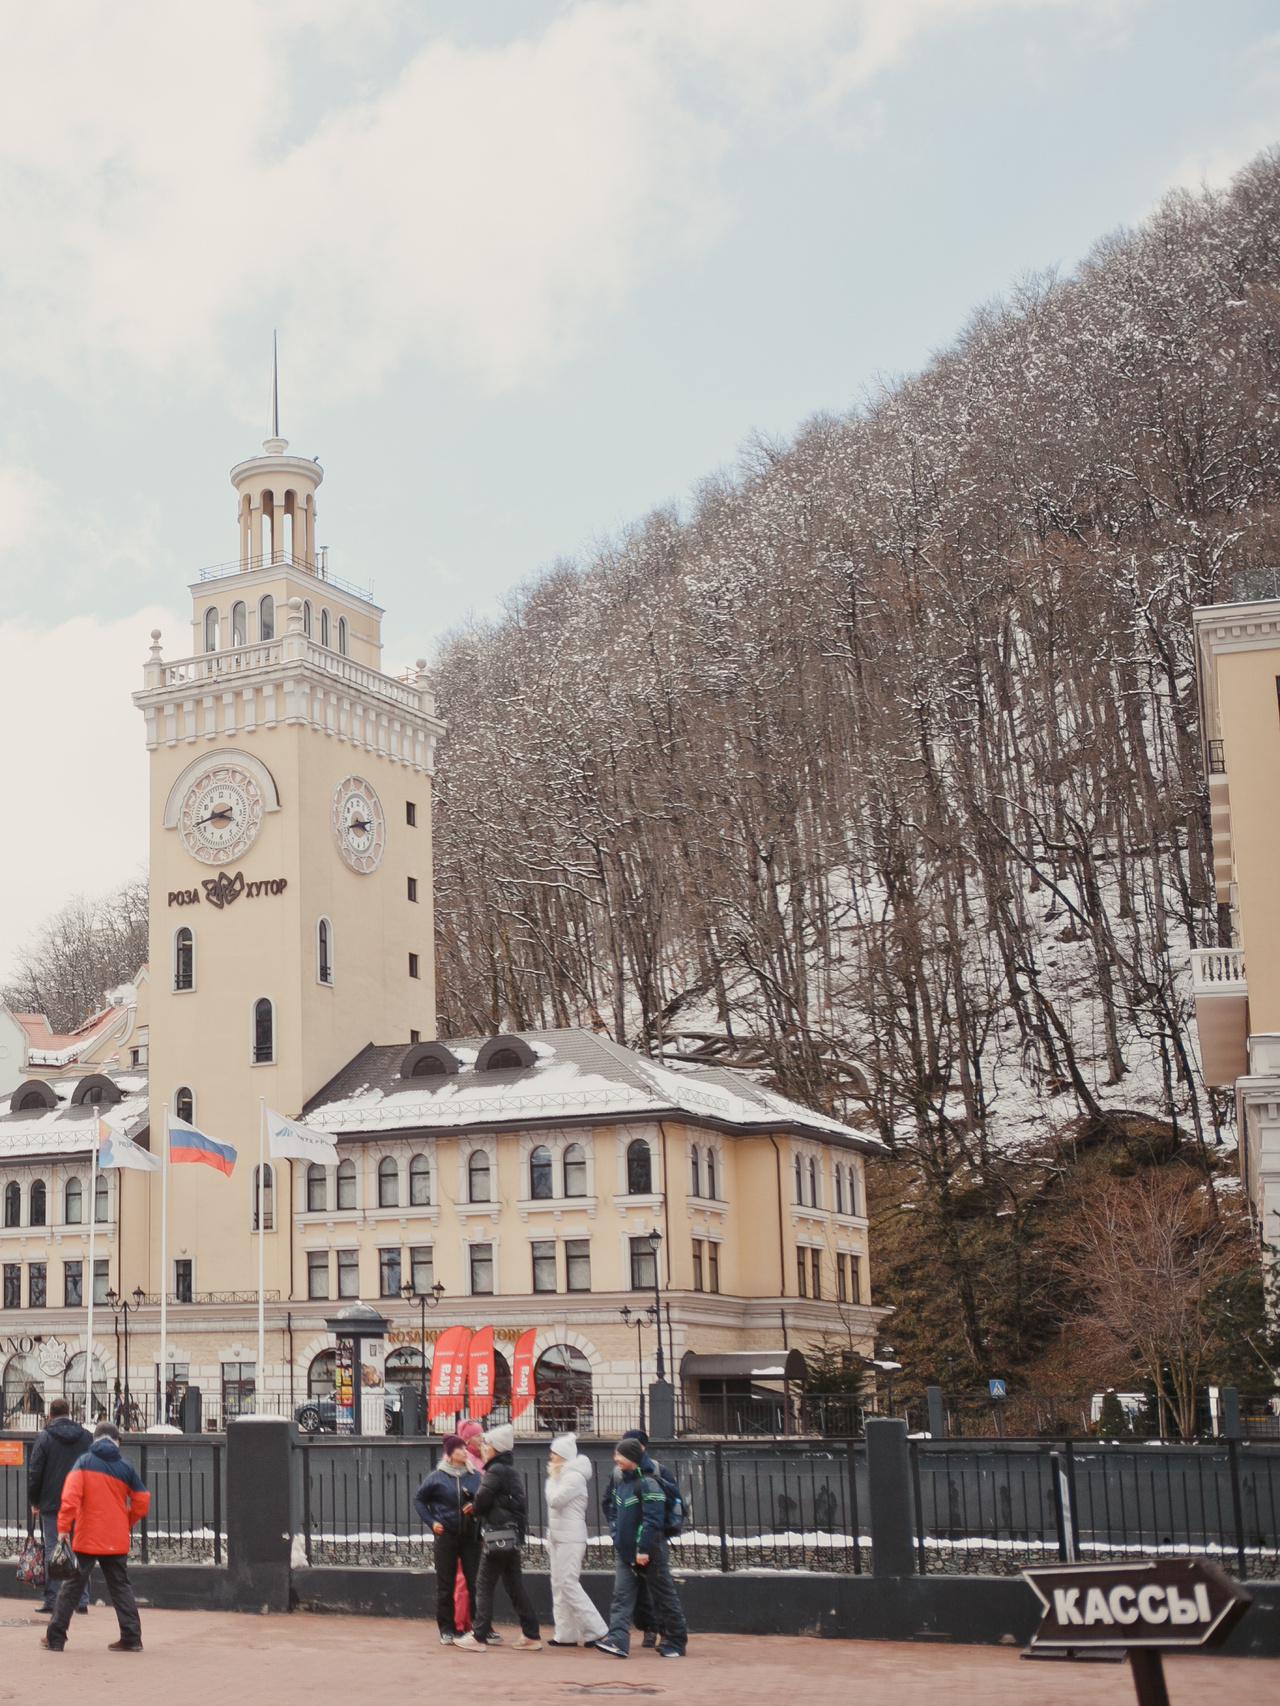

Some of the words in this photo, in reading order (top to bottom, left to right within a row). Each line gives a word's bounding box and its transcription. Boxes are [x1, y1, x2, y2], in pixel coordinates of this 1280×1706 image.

[168, 888, 200, 907] РОЗА
[246, 878, 288, 898] ХУТОР
[388, 1330, 421, 1343] ROSA
[1053, 1583, 1212, 1626] КАССЫ
